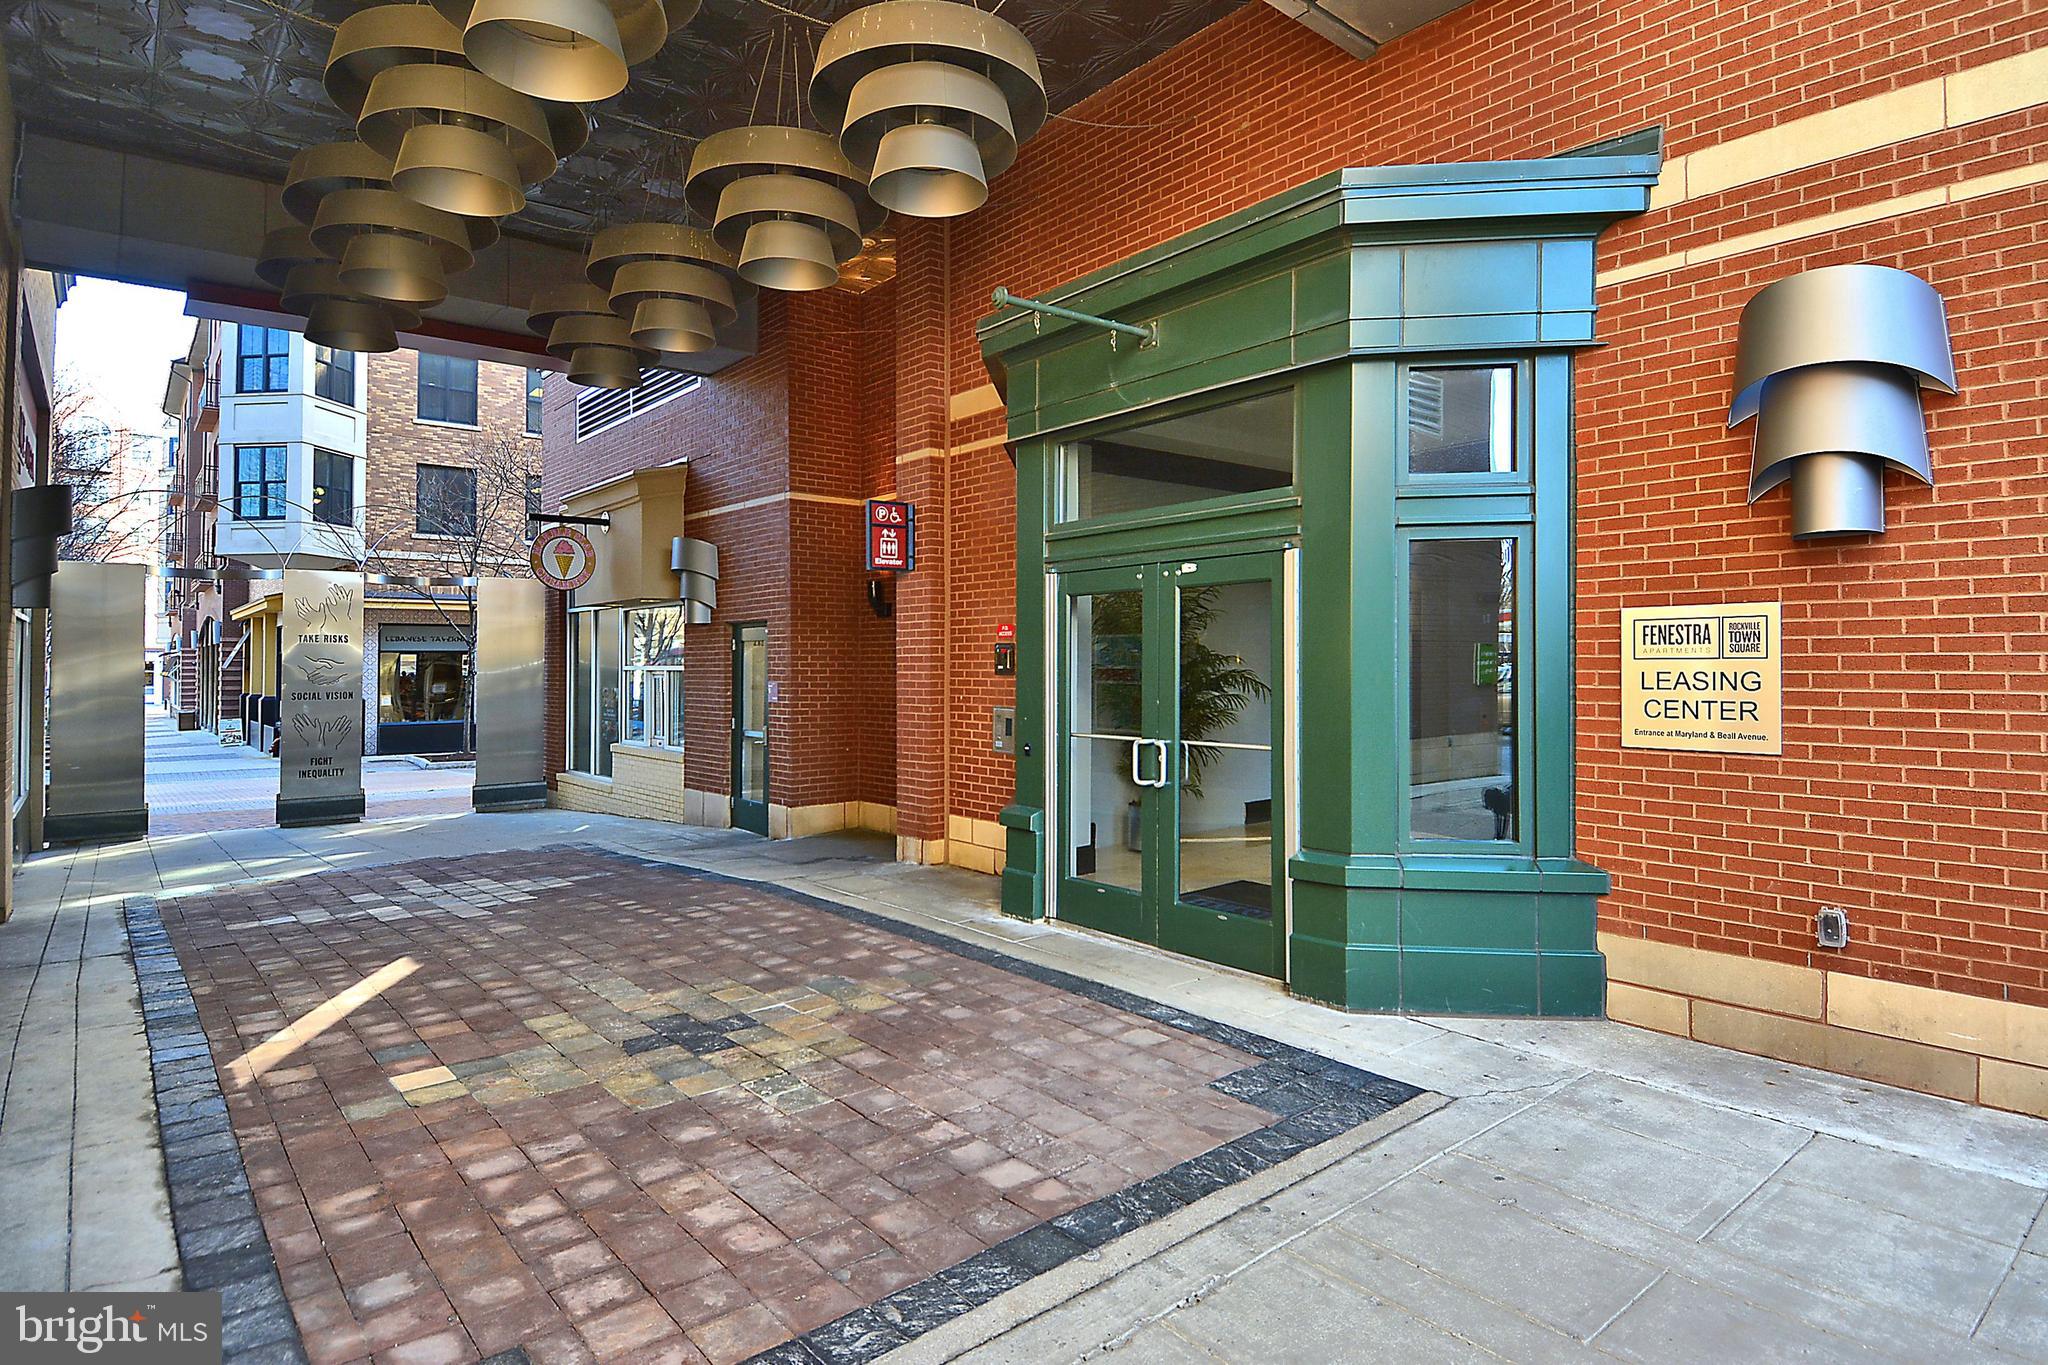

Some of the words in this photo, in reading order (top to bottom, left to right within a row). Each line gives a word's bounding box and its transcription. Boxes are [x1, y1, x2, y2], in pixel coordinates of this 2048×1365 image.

[875, 557, 903, 565] Elevator
[1728, 622, 1760, 630] ROCKVILLE
[298, 634, 321, 644] TAKE
[323, 634, 349, 643] RISKS
[1642, 624, 1711, 646] FENESTRA
[1728, 630, 1760, 643] TOWN
[1729, 643, 1760, 653] SQUARE
[1641, 671, 1761, 692] LEASING
[291, 692, 321, 701] SOCIAL
[326, 690, 354, 700] VISION
[1644, 699, 1759, 721] CENTER
[1634, 729, 1664, 737] Entrance
[1675, 730, 1708, 740] Maryland
[1717, 731, 1736, 740] Beall
[310, 757, 333, 766] FIGHT
[298, 768, 345, 779] INEQUALITY
